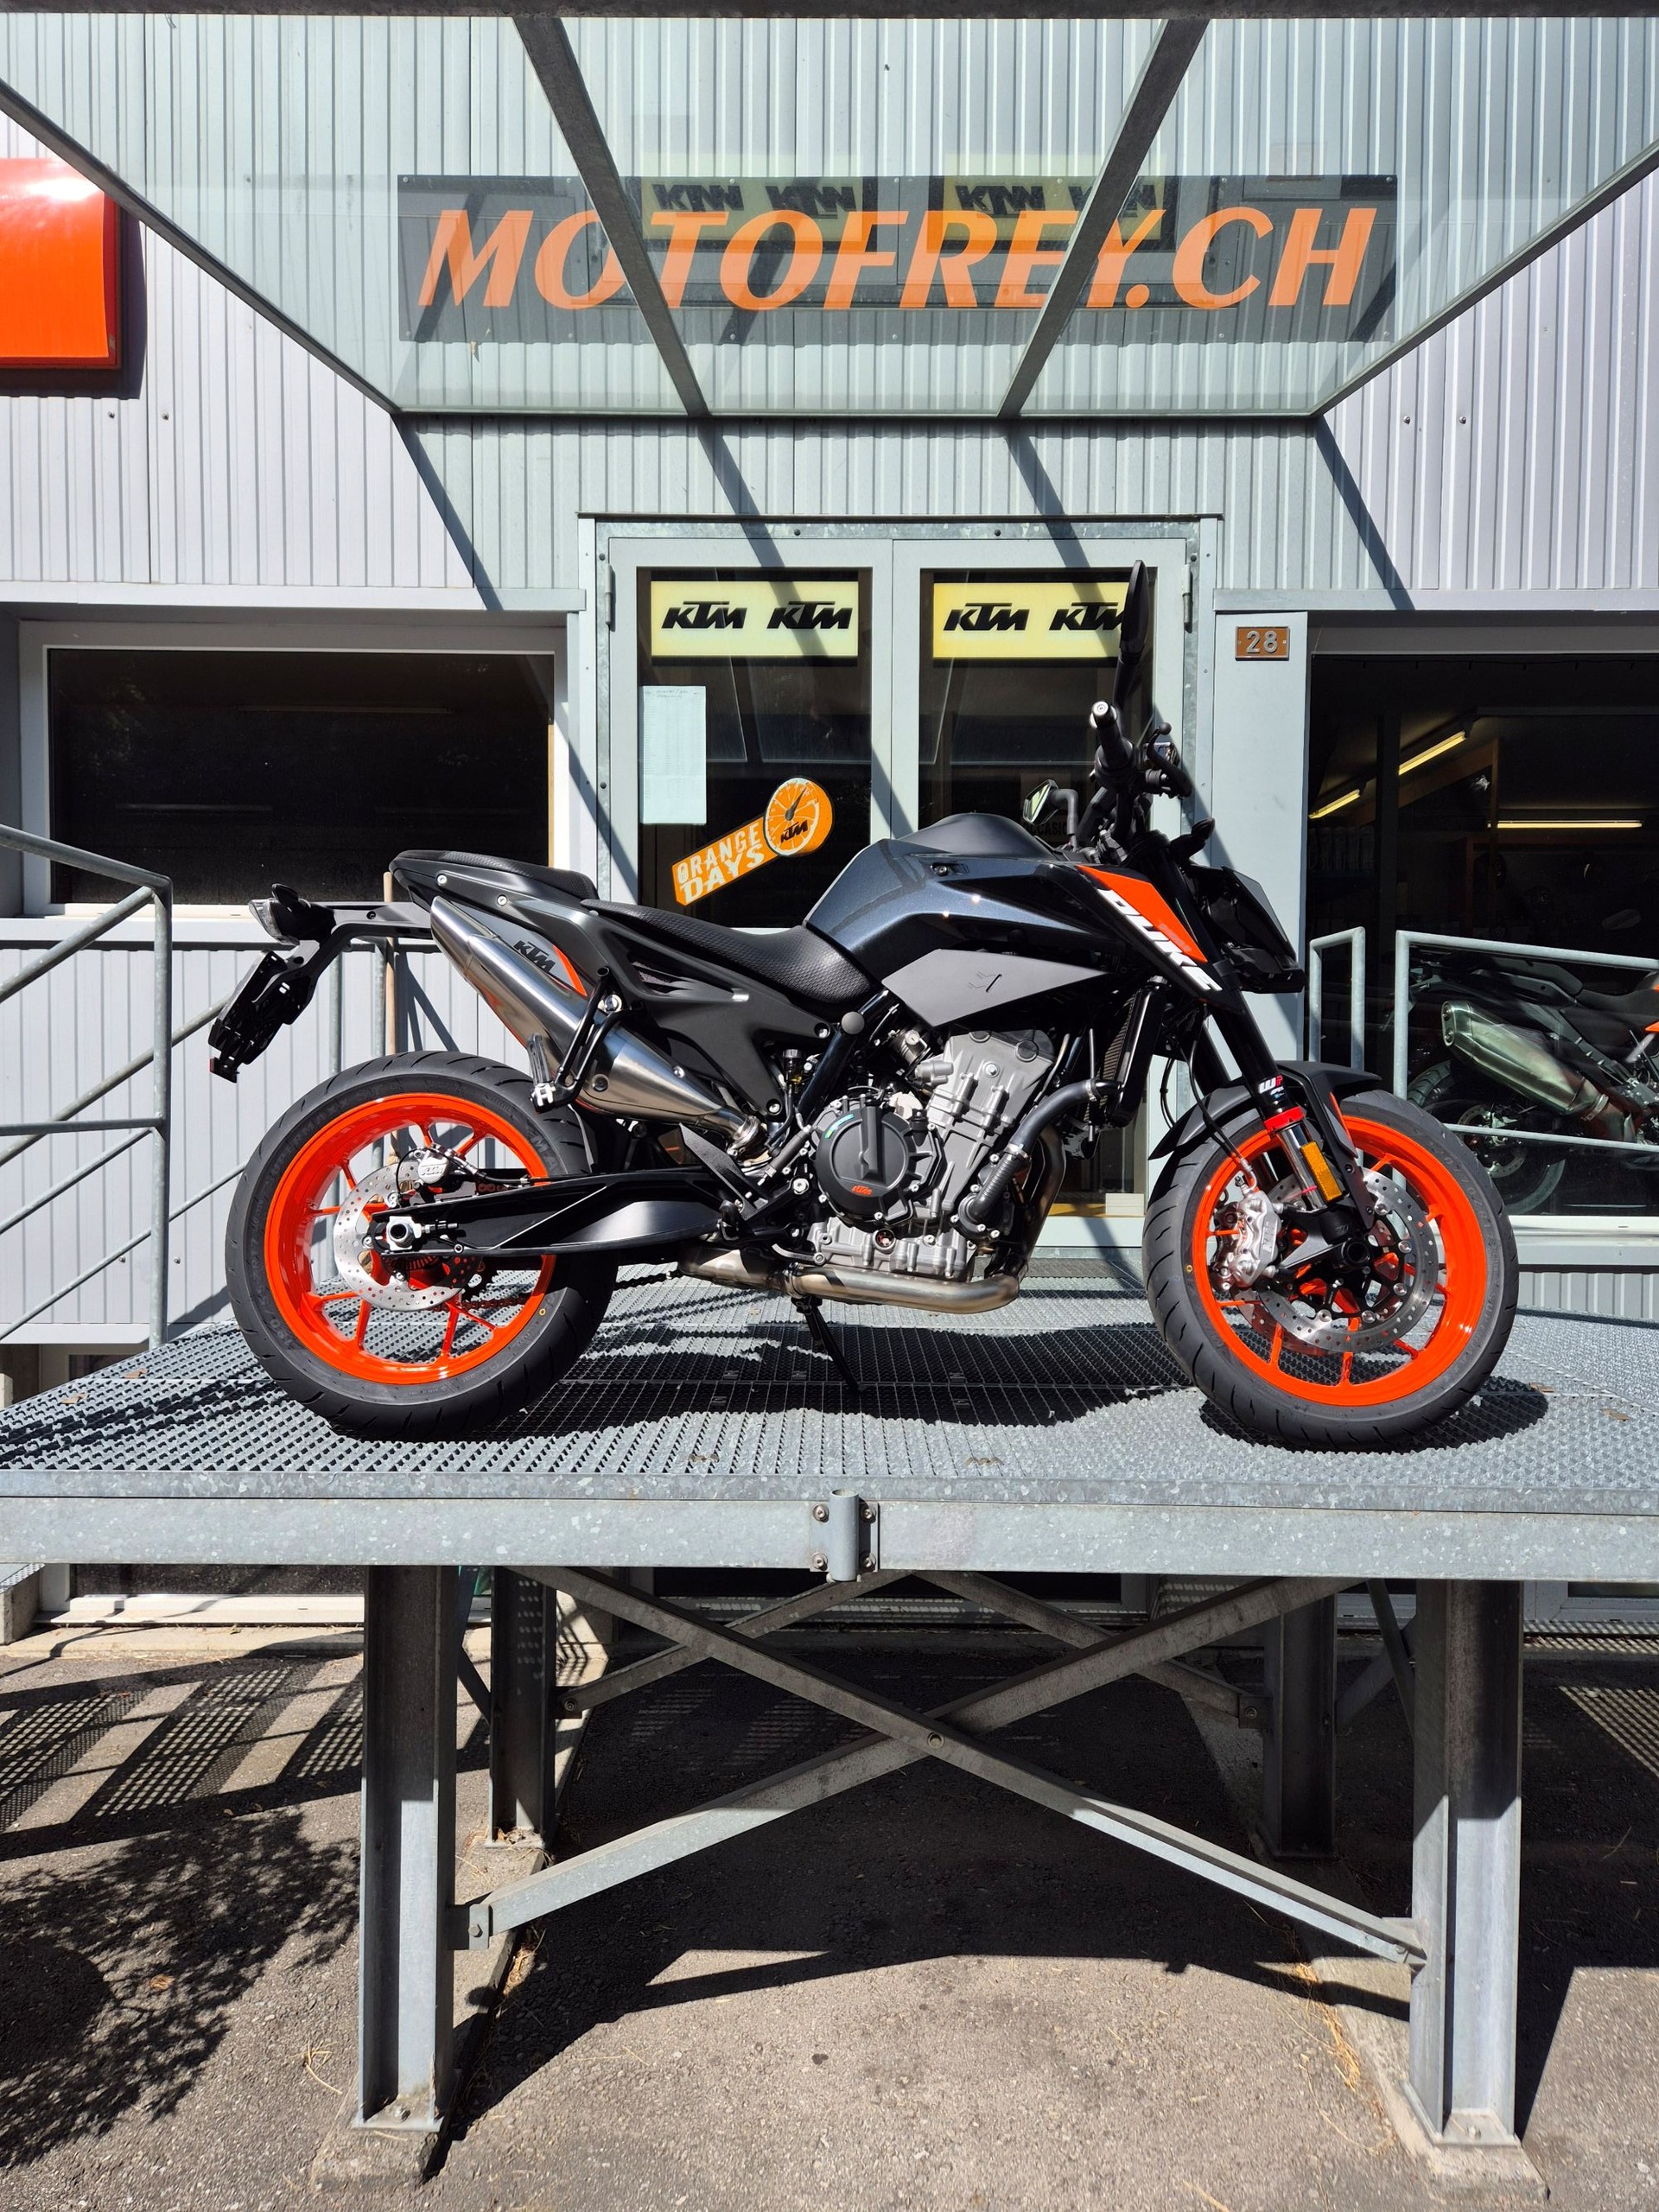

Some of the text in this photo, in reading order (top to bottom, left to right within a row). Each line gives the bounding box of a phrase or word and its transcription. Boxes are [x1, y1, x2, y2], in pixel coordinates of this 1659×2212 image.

[419, 207, 1377, 310] MOTOFREY.CH
[661, 601, 853, 630] KTM KTM
[943, 602, 1030, 631] KTM
[1246, 630, 1278, 653] 28
[780, 820, 809, 844] KTM
[677, 822, 762, 885] ORANGE
[680, 843, 765, 904] DAYS
[513, 938, 557, 975] KTM
[1097, 888, 1223, 991] DUKE
